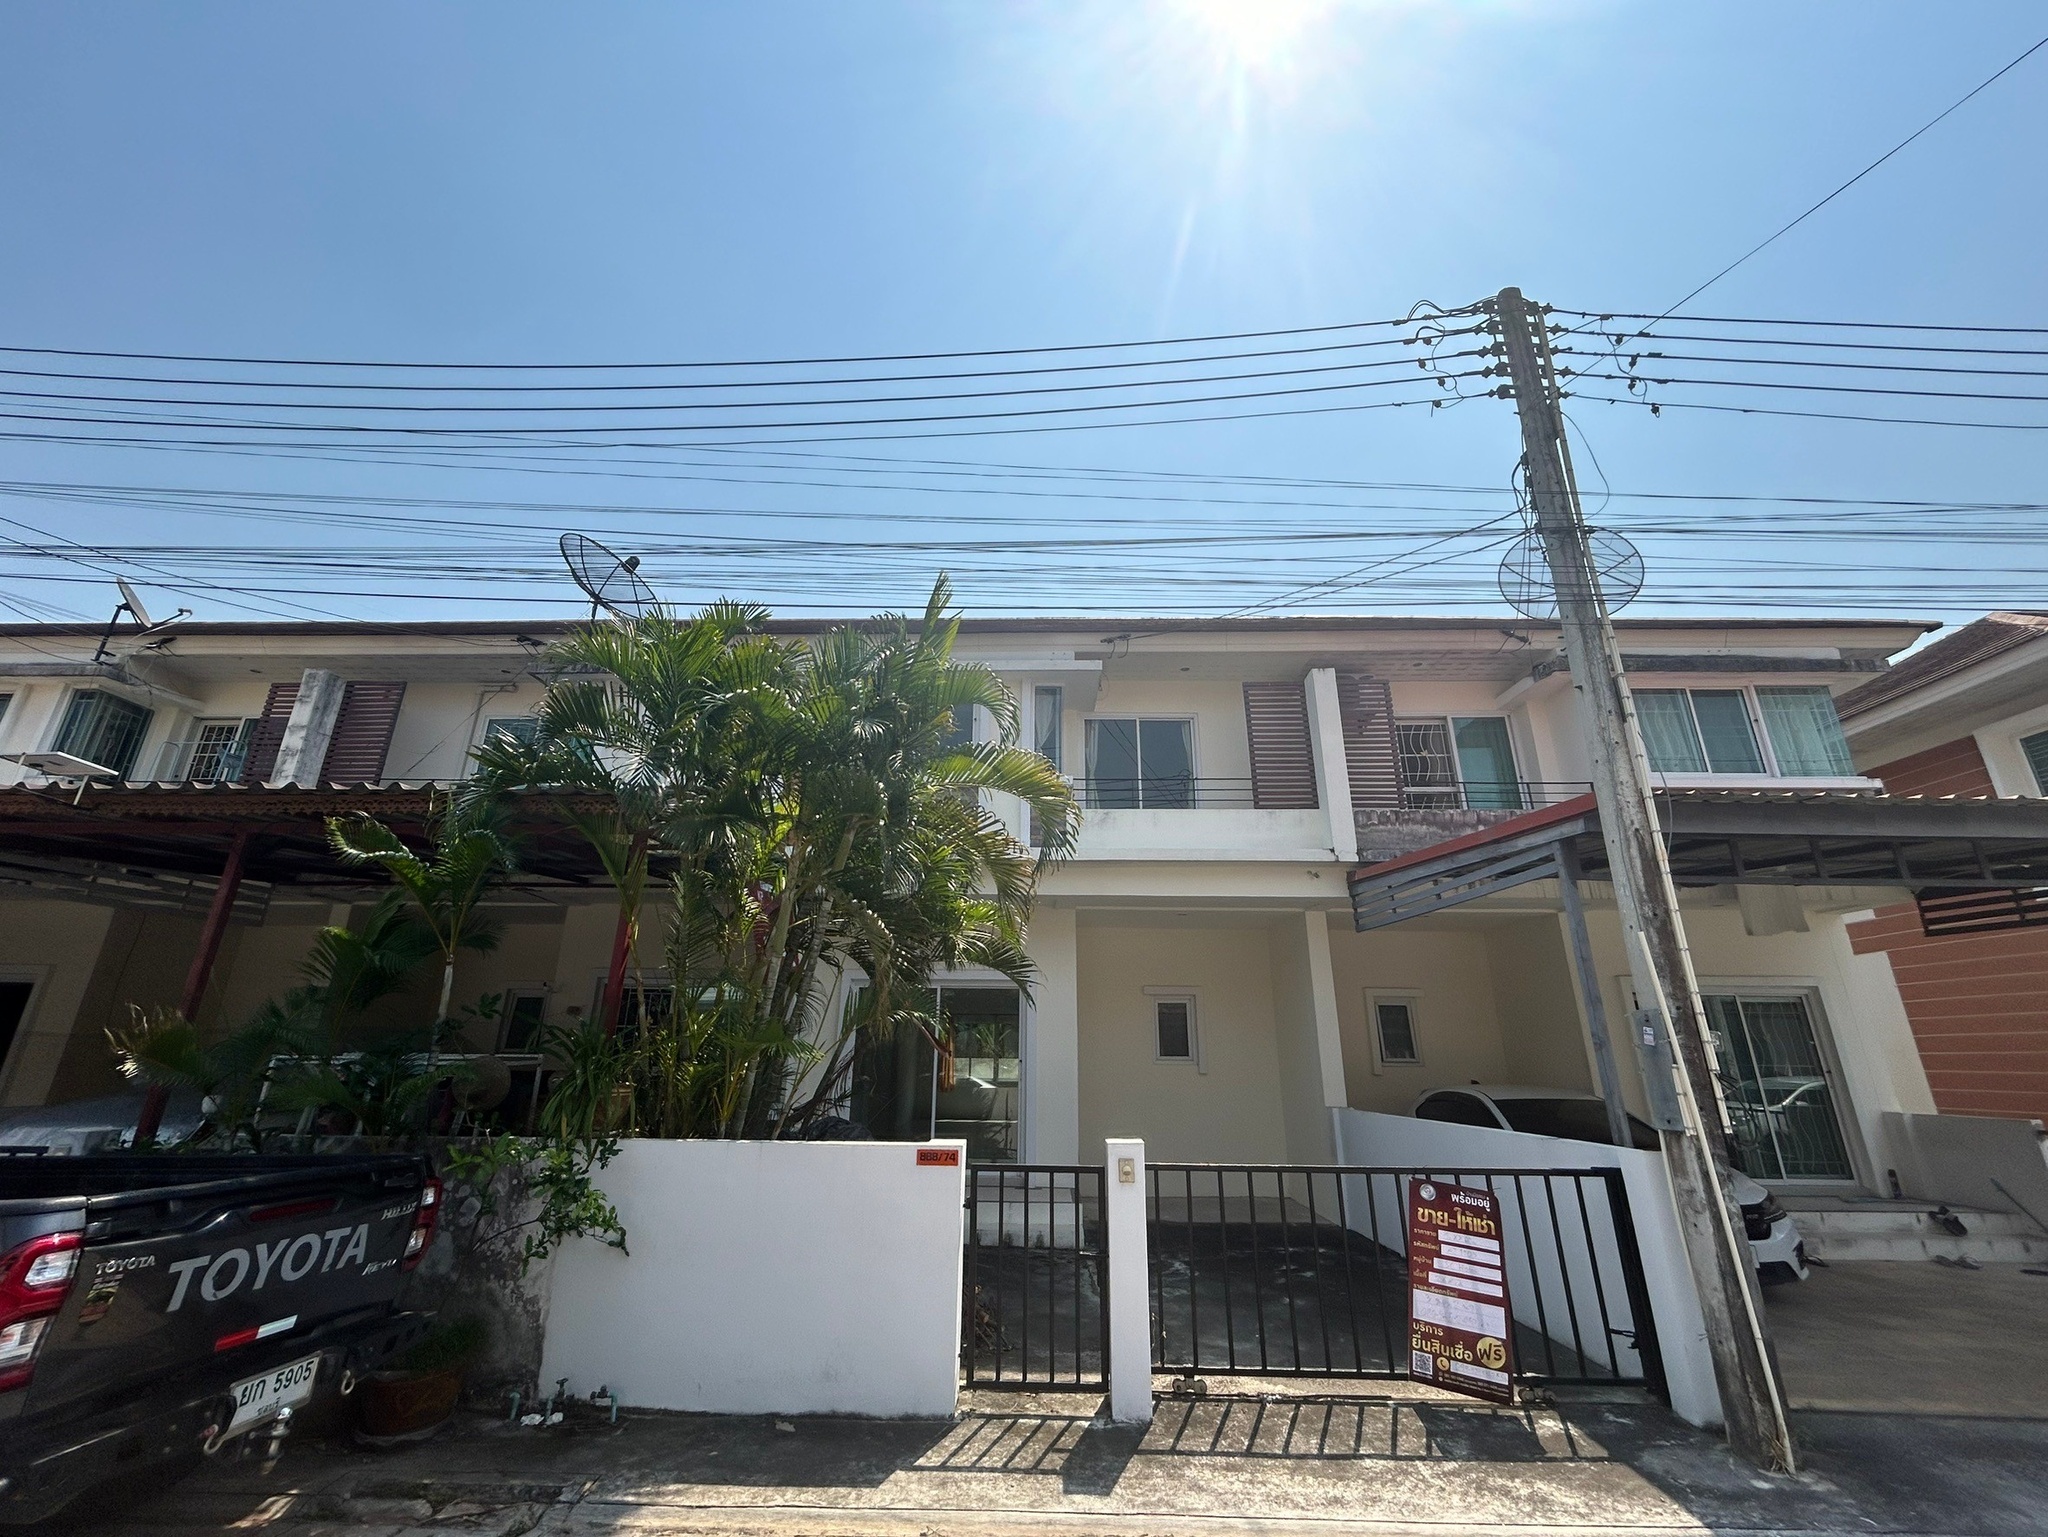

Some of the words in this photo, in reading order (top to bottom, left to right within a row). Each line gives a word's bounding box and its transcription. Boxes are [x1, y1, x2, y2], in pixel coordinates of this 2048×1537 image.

[920, 1152, 956, 1163] 888/74
[1450, 1191, 1491, 1212] พร้อมอยู่
[1417, 1206, 1496, 1236] ขาย-ให้เช่า
[96, 1255, 156, 1275] TOYOTA
[165, 1223, 369, 1313] TOYOTA
[1412, 1321, 1444, 1337] บริการ
[1411, 1331, 1473, 1362] ยื่นสินเชื่อ
[1478, 1343, 1503, 1362] ฟรี
[239, 1379, 266, 1408] ยก
[273, 1360, 315, 1393] 5905
